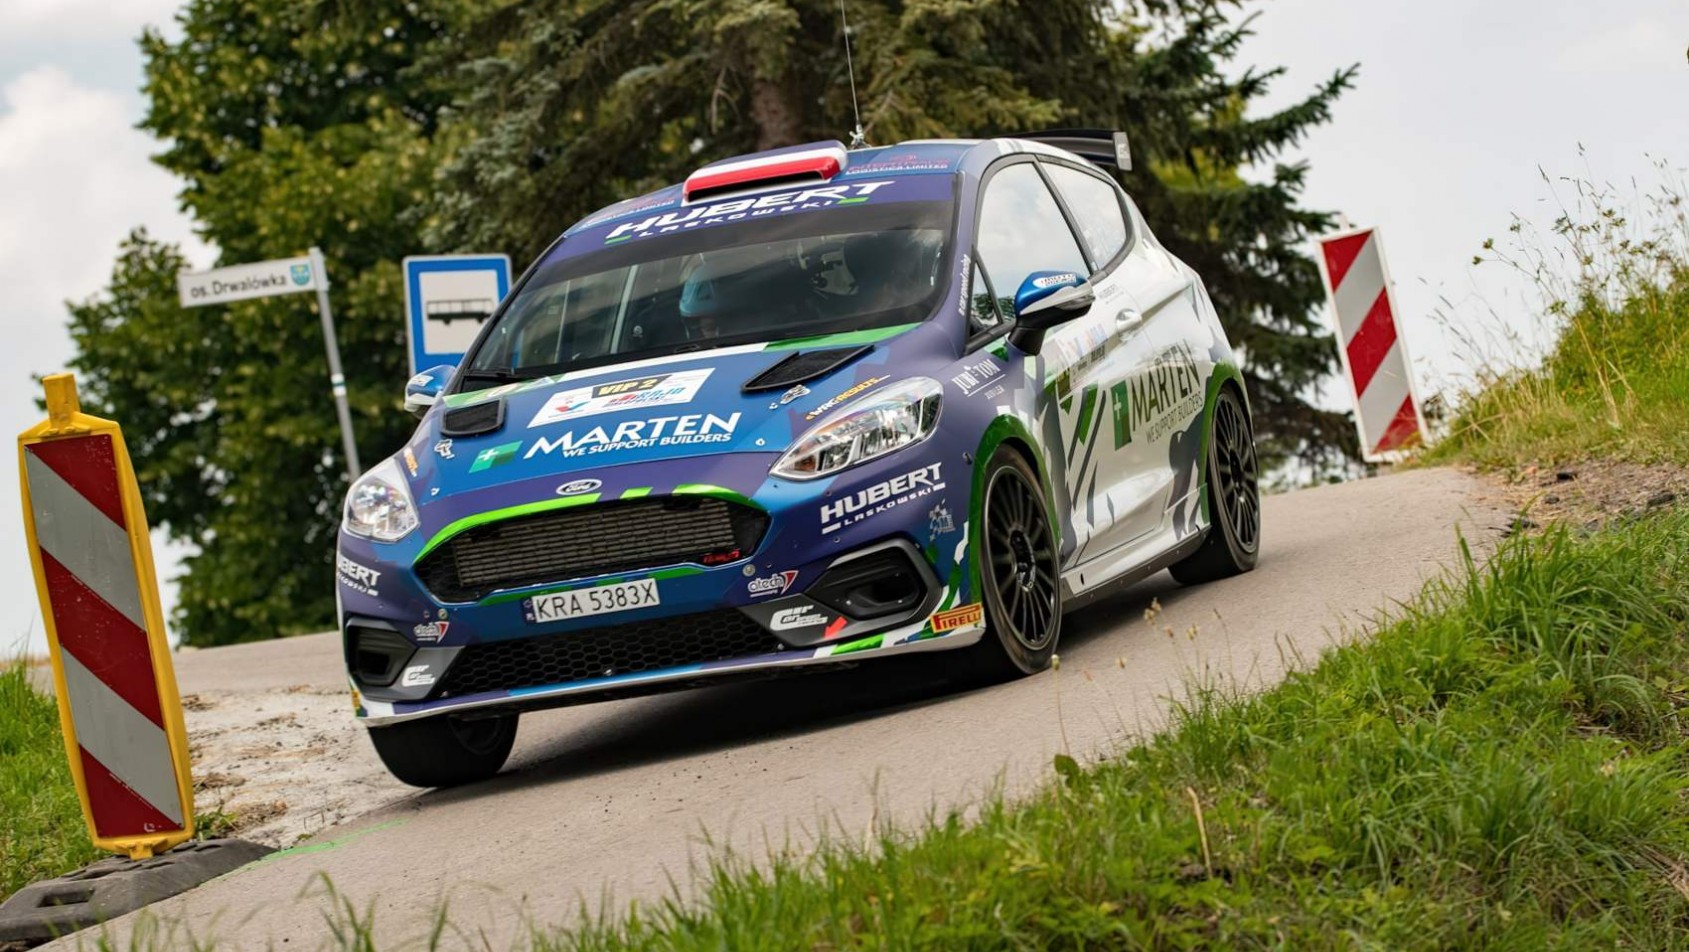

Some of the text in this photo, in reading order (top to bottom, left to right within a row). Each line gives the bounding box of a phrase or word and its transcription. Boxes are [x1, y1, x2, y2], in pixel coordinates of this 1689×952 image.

[605, 180, 896, 239] HUBERT
[638, 200, 831, 238] LASKOWSKI
[191, 286, 210, 298] os.
[597, 378, 658, 396] VIP 2
[1130, 337, 1201, 432] MARTEN
[1177, 390, 1204, 422] BUILDERS
[523, 412, 742, 460] MARTEN
[563, 432, 732, 458] WE SUPPORT BUILDERS
[820, 461, 942, 524] HUBERT
[843, 487, 932, 526] LASKOWSKI
[536, 582, 657, 619] KRA 5383X
[932, 605, 982, 631] PIRELLI
